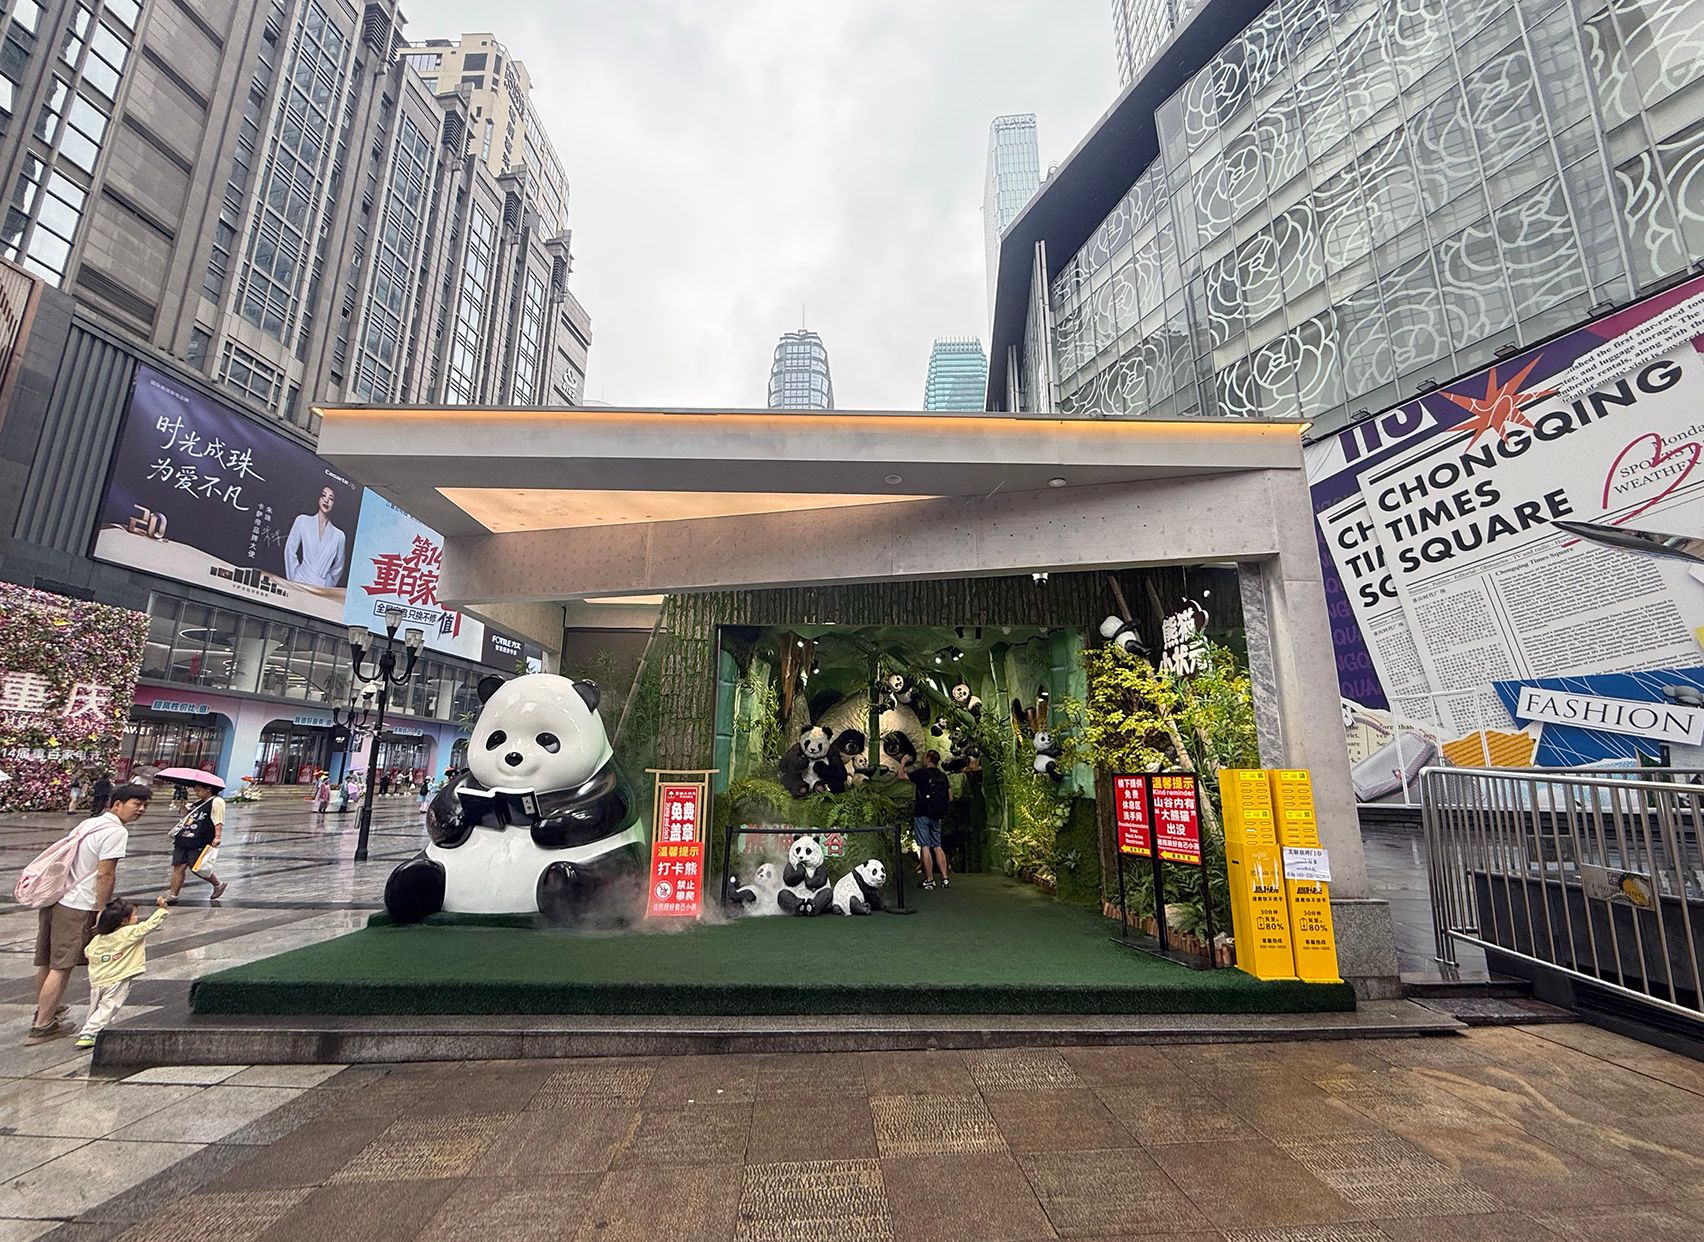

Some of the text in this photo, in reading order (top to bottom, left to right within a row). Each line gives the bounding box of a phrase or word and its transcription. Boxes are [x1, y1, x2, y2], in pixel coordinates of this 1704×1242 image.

[1597, 347, 1612, 358] the
[1614, 336, 1634, 349] first
[1636, 308, 1685, 337] star-rated
[1634, 343, 1663, 358] along
[1664, 328, 1687, 342] with
[1580, 365, 1597, 376] and
[1599, 346, 1636, 367] luggage
[1638, 324, 1677, 345] storage.
[1679, 311, 1700, 324] The
[1378, 360, 1682, 512] CHONGQING
[156, 415, 266, 481] 时光成珠
[147, 458, 250, 511] 为爱不凡
[325, 469, 348, 485] Casarte
[1385, 480, 1501, 543] TIMES
[1402, 488, 1574, 573] SQUARE
[1526, 694, 1695, 736] FASHION
[1152, 776, 1194, 790] 温馨提示
[1124, 789, 1139, 799] 免费
[1153, 797, 1195, 809] 山谷内有
[671, 801, 695, 821] 免费
[670, 822, 694, 842] 盖章
[1166, 823, 1186, 836] 出没
[658, 846, 699, 857] 温馨提示
[657, 862, 698, 876] 打卡熊
[676, 880, 695, 890] 禁止
[1265, 923, 1284, 931] 80%
[1308, 924, 1328, 932] 80%
